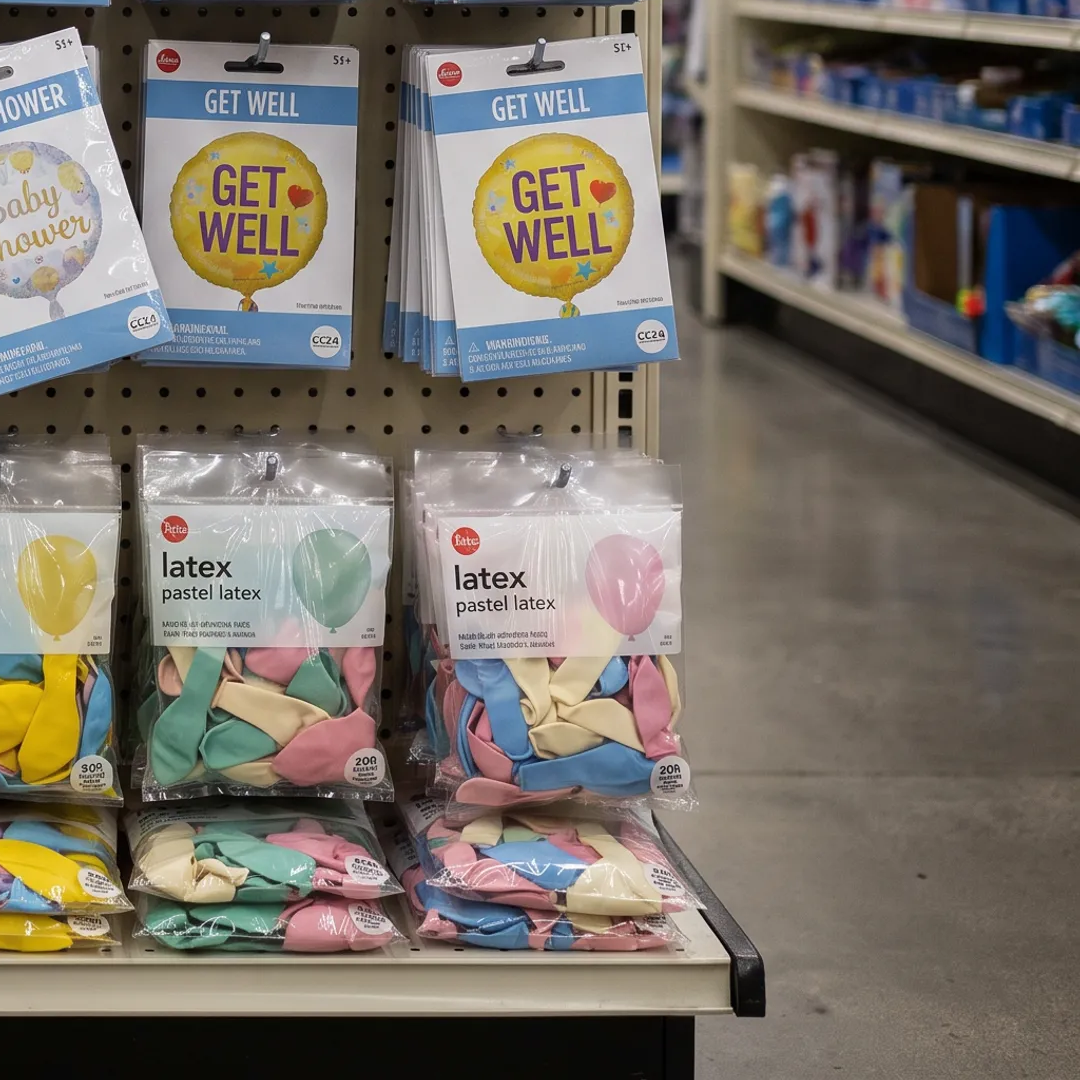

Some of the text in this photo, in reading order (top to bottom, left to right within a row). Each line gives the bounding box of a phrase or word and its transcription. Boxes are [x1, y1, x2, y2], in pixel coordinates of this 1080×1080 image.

[204, 89, 299, 117] GET WELL
[492, 87, 590, 122] GET WELL
[213, 164, 286, 209] GET
[512, 164, 585, 214] GET
[199, 211, 299, 257] WELL
[503, 212, 612, 264] WELL
[162, 552, 232, 578] latex
[454, 565, 527, 590] latex
[162, 584, 261, 603] pastel latex
[456, 595, 555, 617] pastel latex
